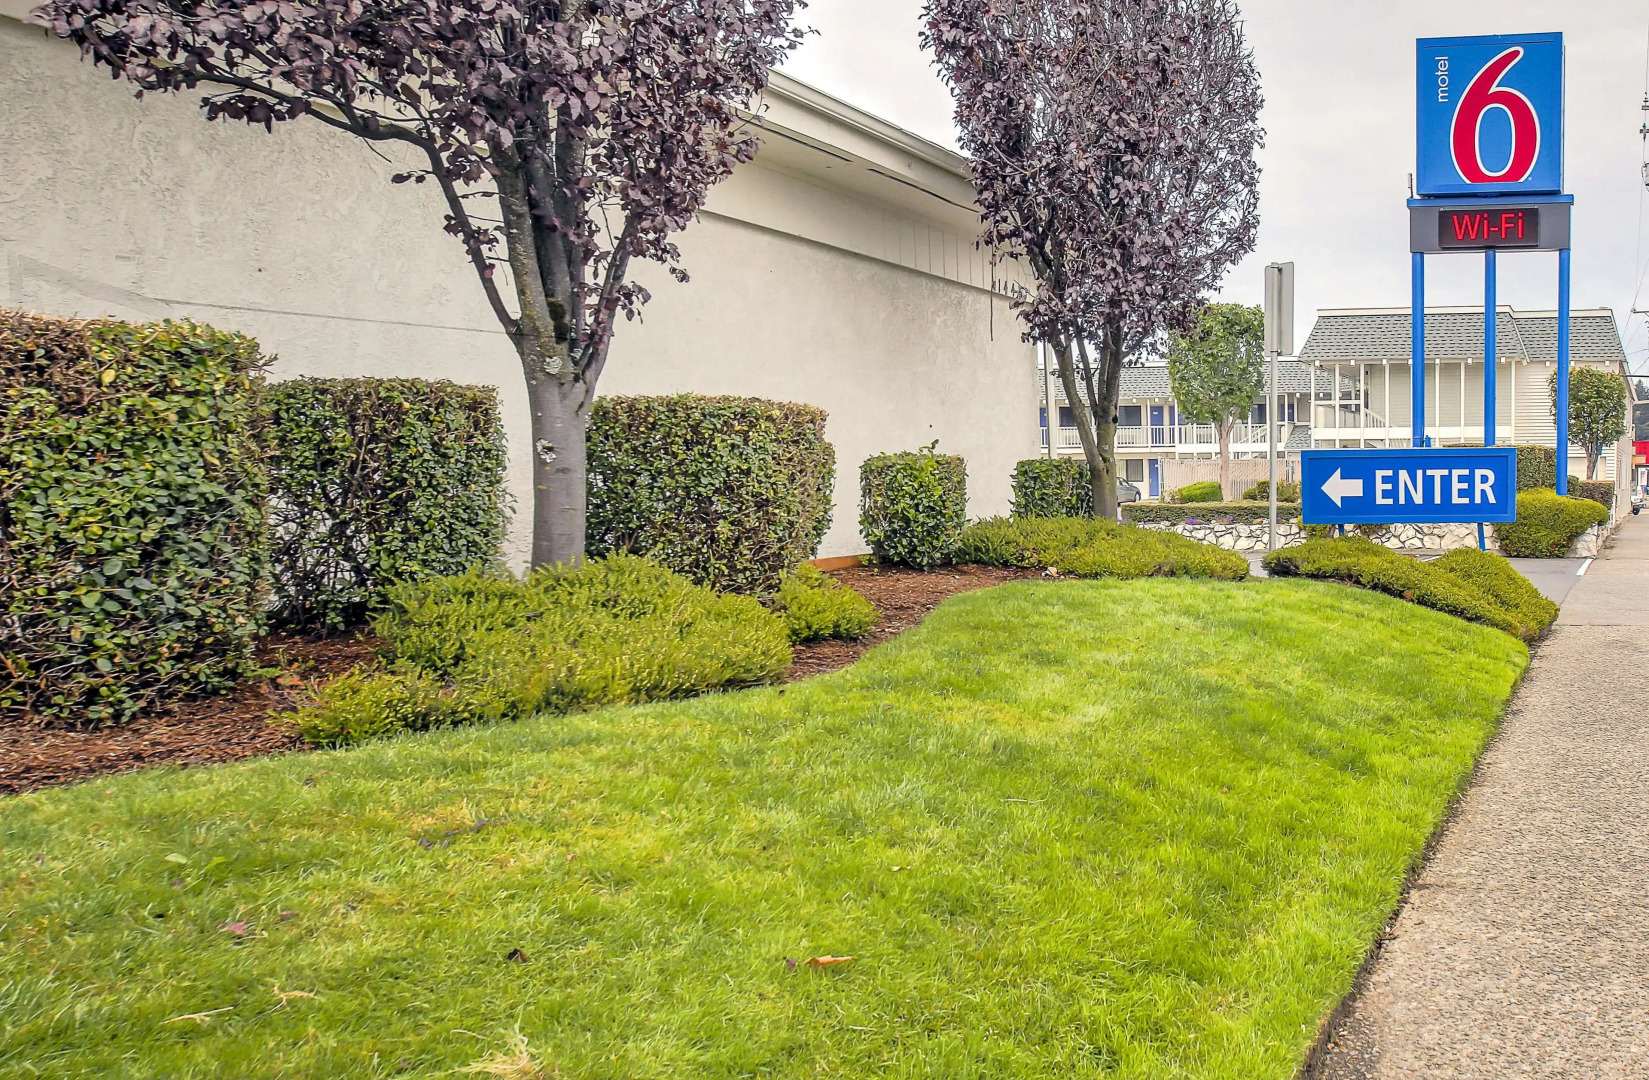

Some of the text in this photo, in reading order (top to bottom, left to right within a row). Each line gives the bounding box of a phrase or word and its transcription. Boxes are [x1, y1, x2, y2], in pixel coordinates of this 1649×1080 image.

[1435, 56, 1449, 102] motel
[1450, 46, 1541, 184] 6
[1452, 212, 1524, 240] Wi-Fi
[1375, 468, 1497, 505] ENTER
